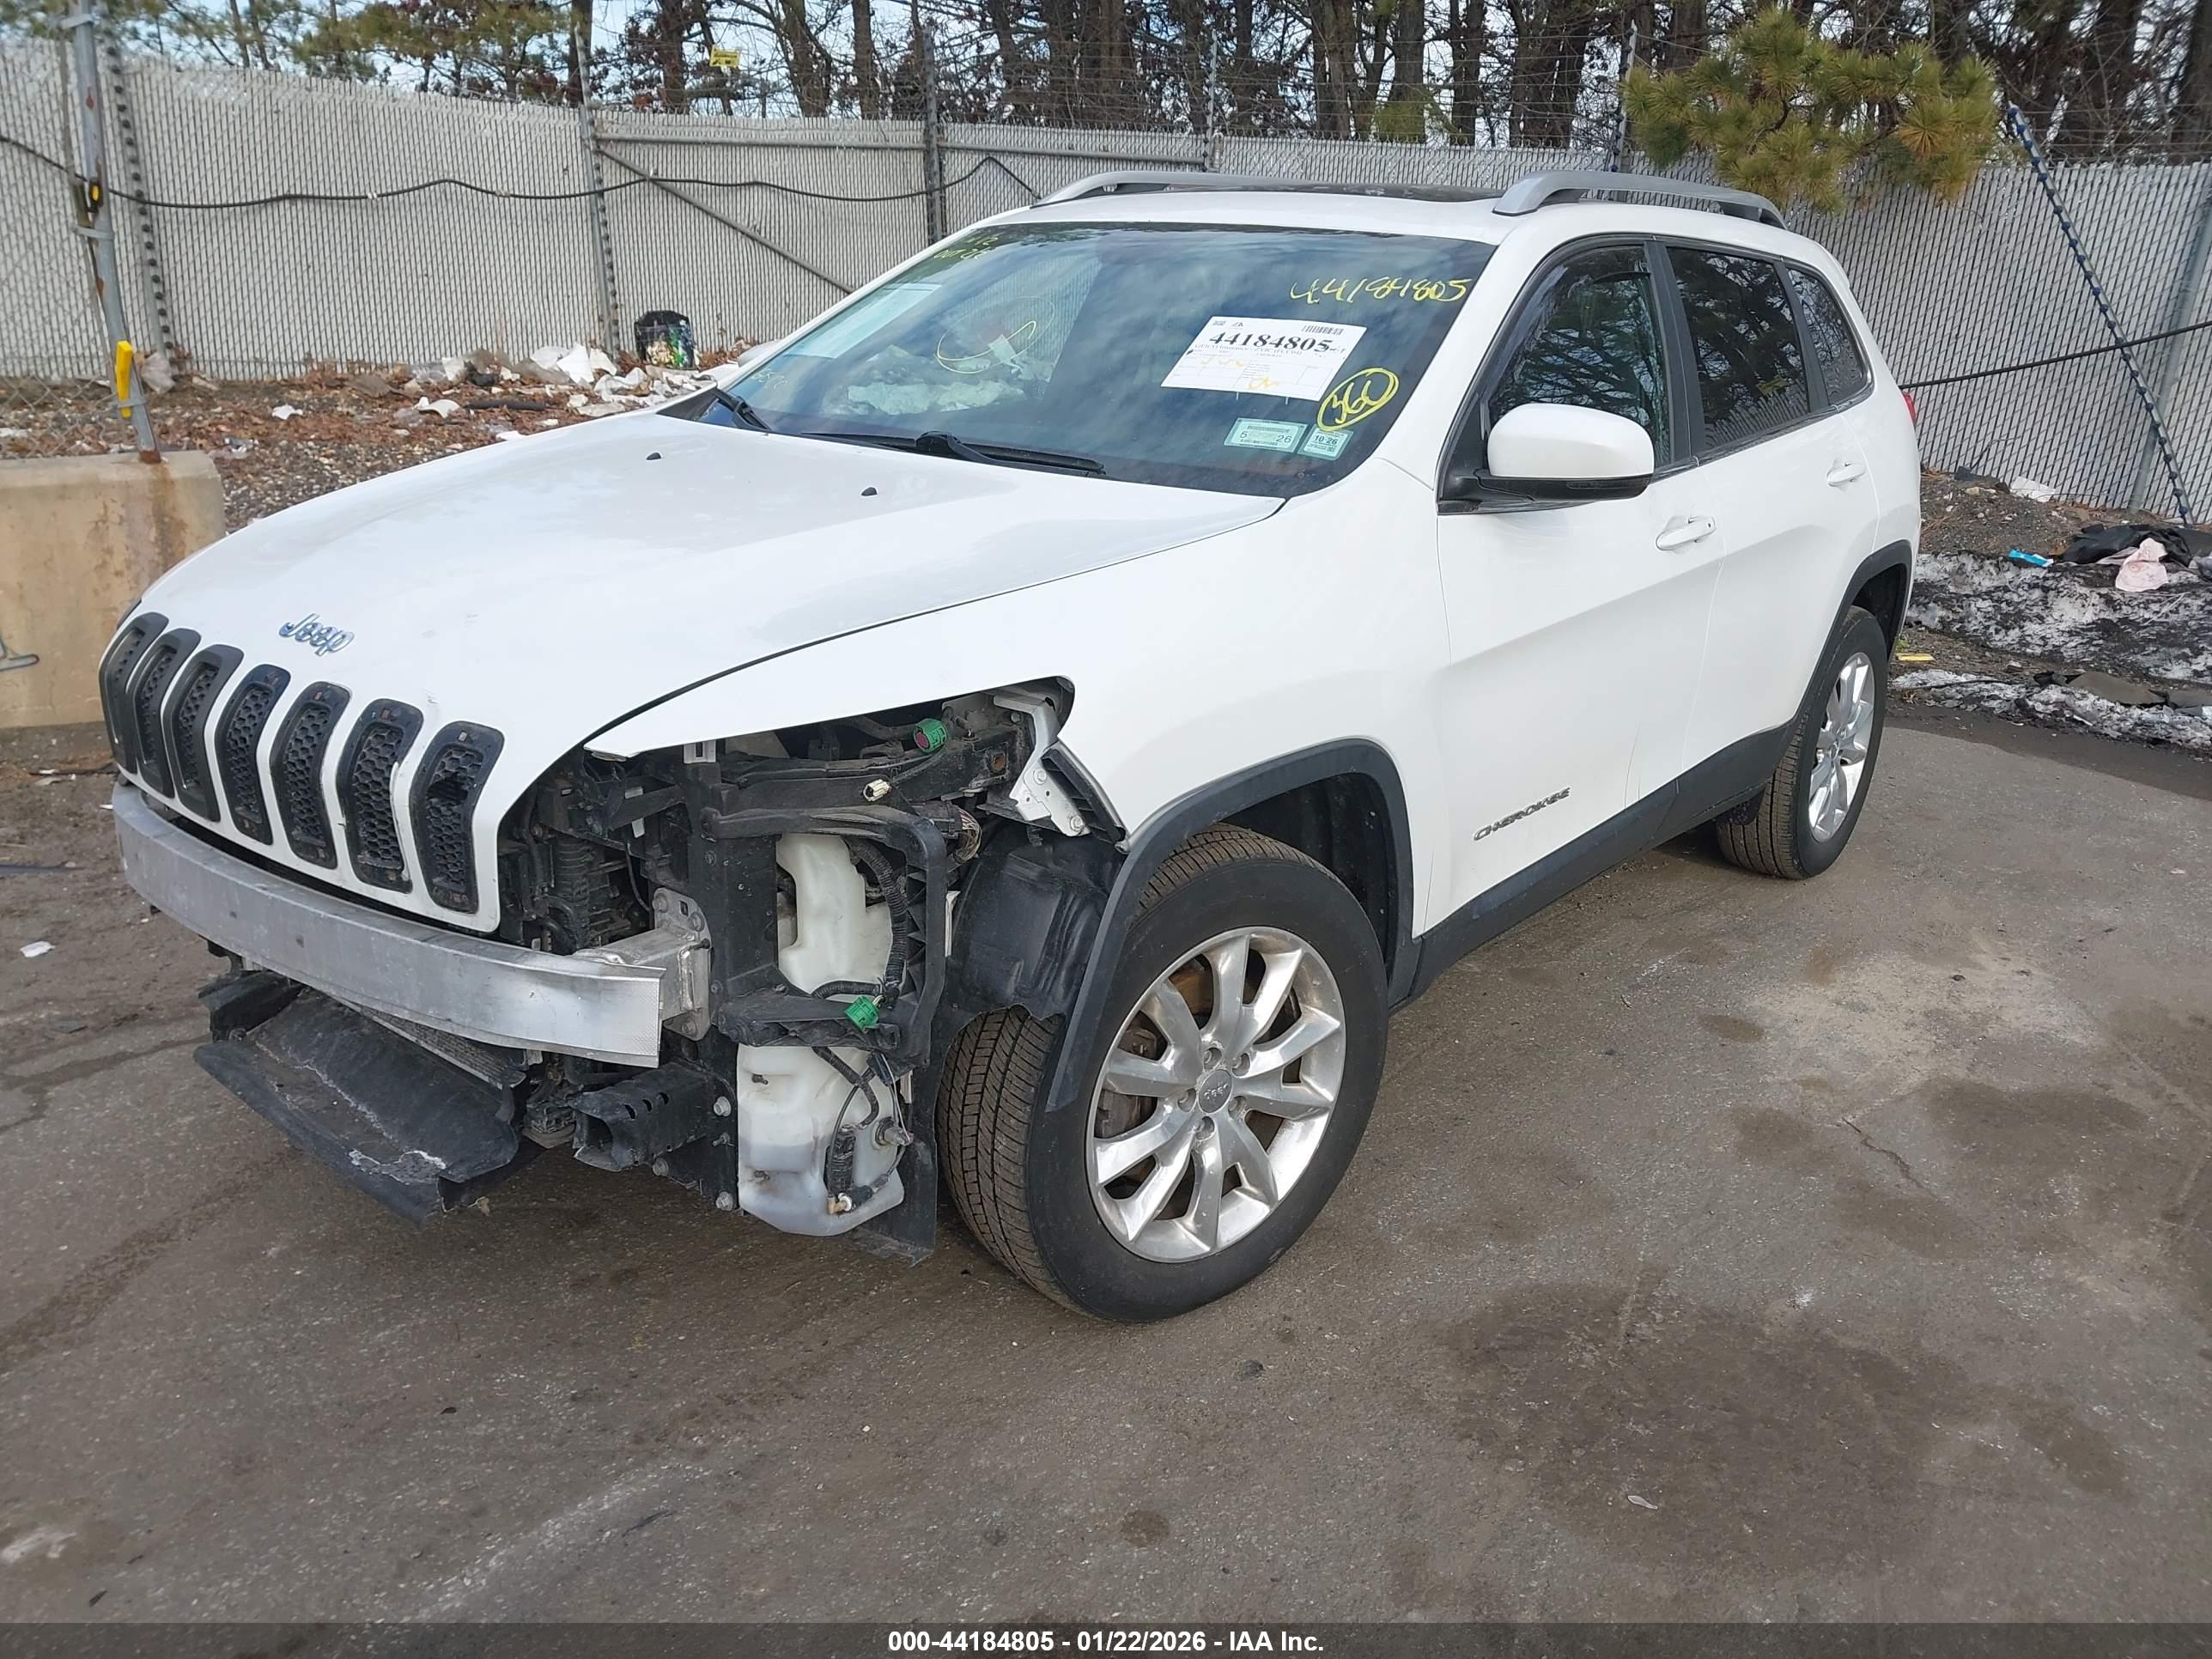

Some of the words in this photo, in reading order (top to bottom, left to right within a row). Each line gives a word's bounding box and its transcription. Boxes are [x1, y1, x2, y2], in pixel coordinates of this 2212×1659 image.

[1209, 331, 1333, 353] 44184805
[1239, 430, 1249, 439] 5
[1276, 434, 1293, 444] 26
[278, 613, 355, 656] Jeep
[1474, 787, 1571, 841] CHEROKEE
